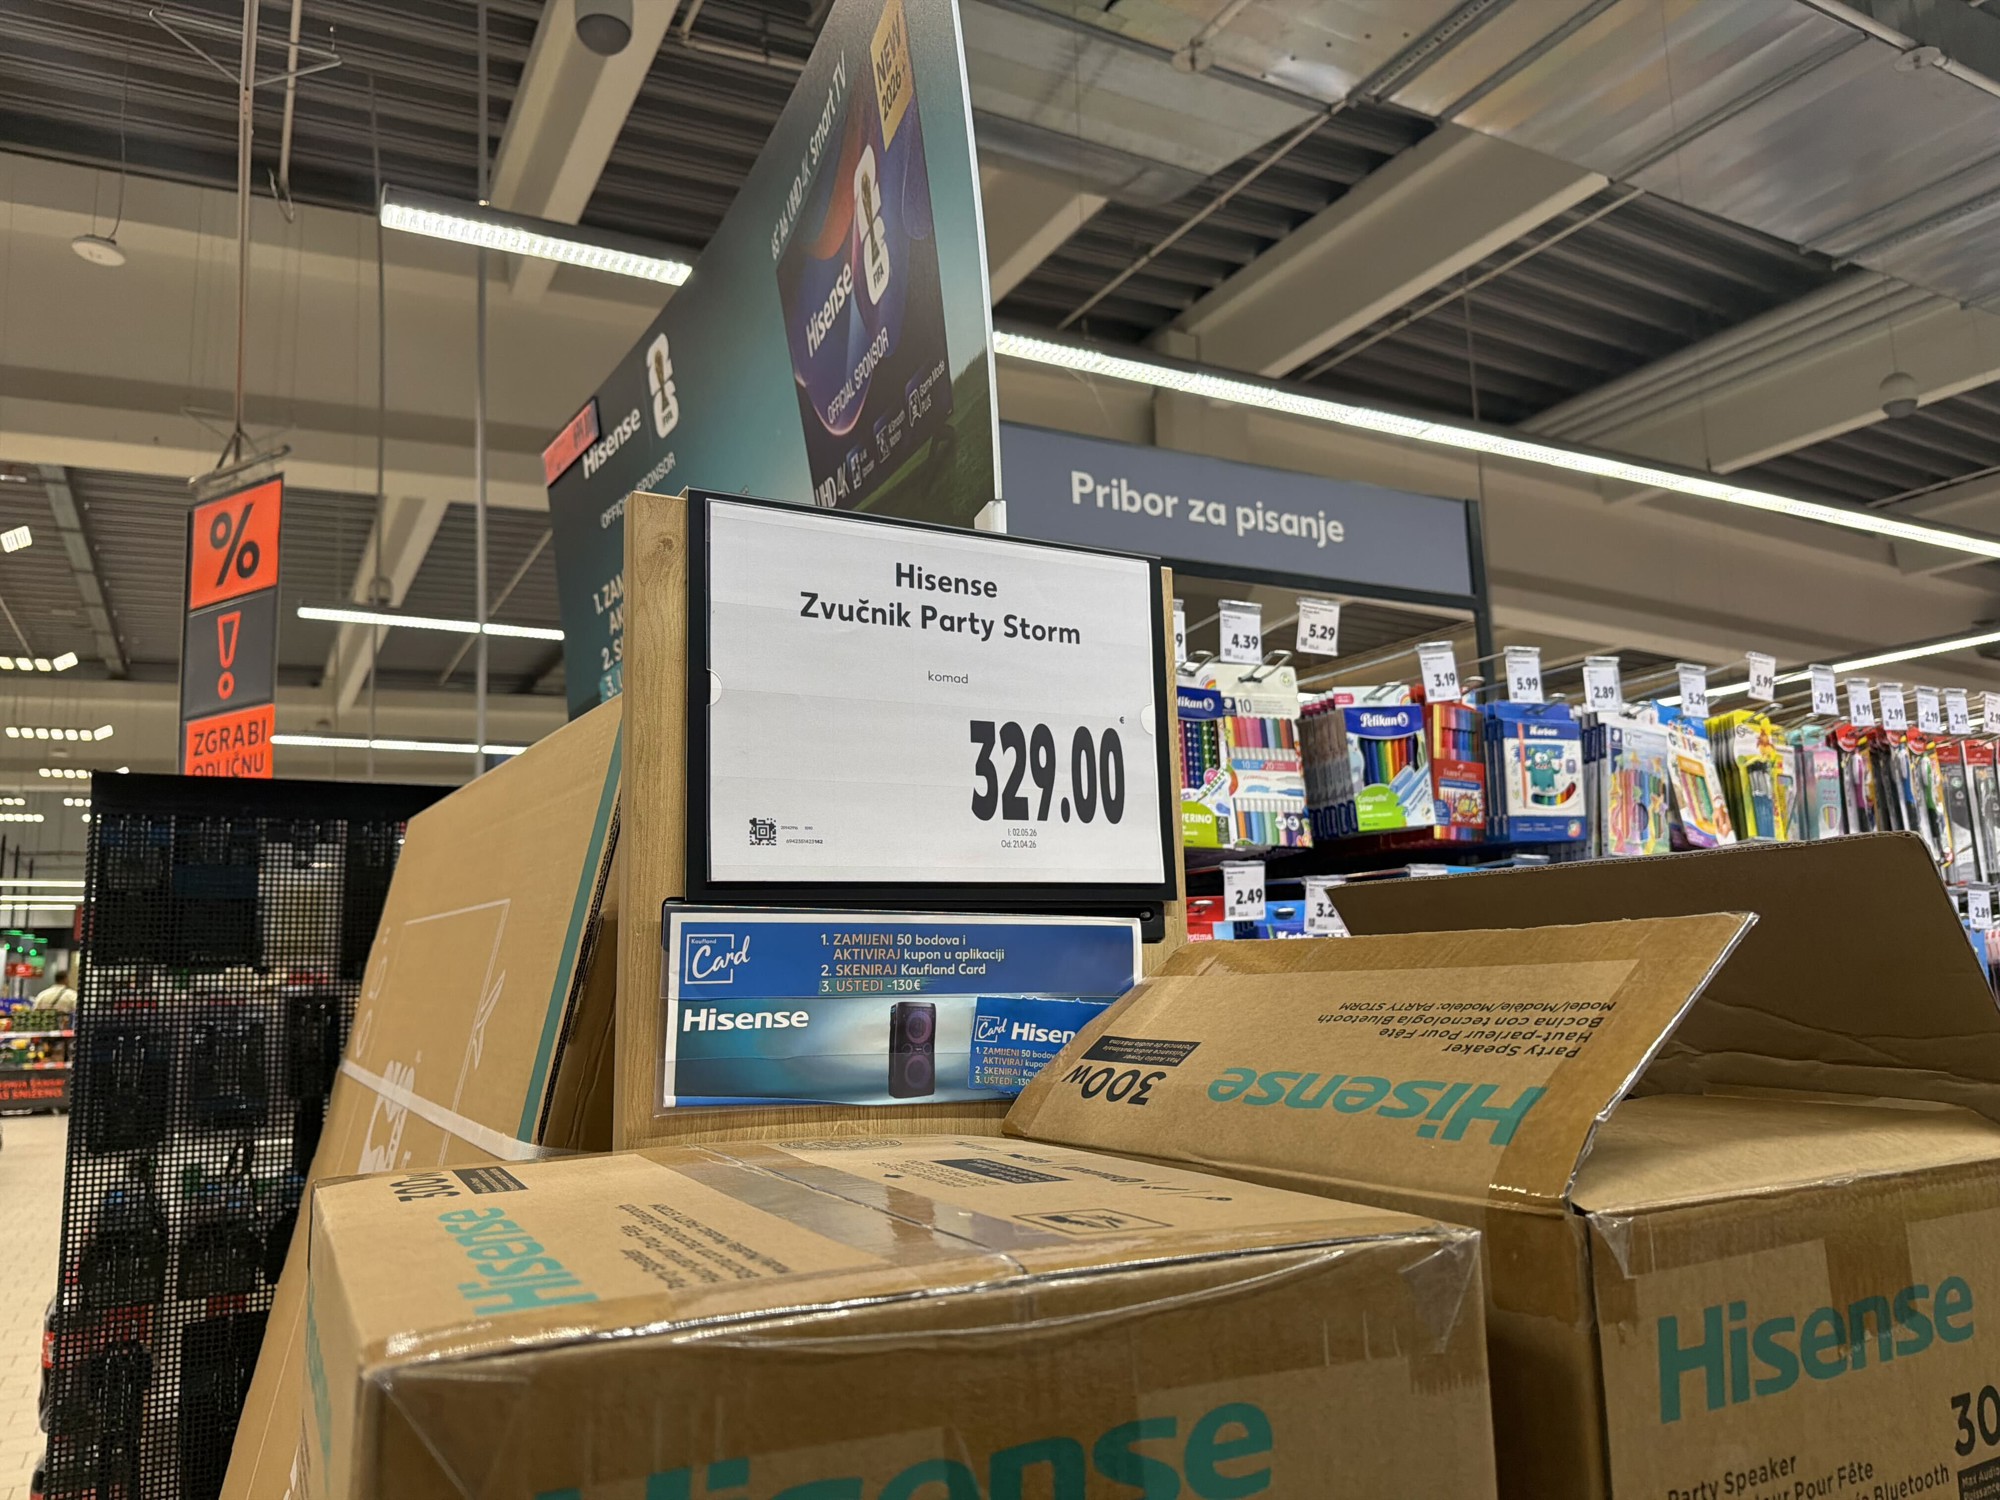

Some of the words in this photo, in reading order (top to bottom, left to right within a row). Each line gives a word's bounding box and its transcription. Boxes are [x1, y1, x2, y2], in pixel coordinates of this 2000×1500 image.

[876, 13, 900, 91] NEW
[882, 71, 900, 121] 2026
[810, 87, 836, 166] Smart
[833, 50, 846, 102] TV
[873, 268, 884, 289] FIFA
[805, 262, 853, 358] Hisense
[827, 382, 855, 425] OFFICIAL
[853, 326, 889, 394] SPONSOR
[582, 408, 642, 480] Hisense
[1070, 469, 1179, 520] Pribor
[1188, 497, 1228, 527] za
[1235, 501, 1346, 549] pisanje
[894, 562, 998, 599] Hisense
[800, 591, 912, 629] Zvučnik
[921, 604, 996, 642] Party
[1003, 614, 1082, 645] Storm
[1308, 623, 1336, 641] 5.29
[1231, 633, 1259, 650] 4.39
[927, 670, 969, 685] komad
[1433, 672, 1456, 688] 3.19
[1516, 677, 1539, 691] 5.99
[1756, 674, 1773, 689] 5.99
[1593, 685, 1615, 700] 2.89
[1688, 692, 1707, 707] 5.29
[1238, 698, 1252, 714] 10
[1359, 712, 1398, 729] Pelikan
[193, 717, 267, 757] ZGRABI
[969, 719, 1126, 825] 329.00
[1012, 828, 1038, 837] 02.05.26
[1001, 840, 1012, 849] Od:
[1013, 840, 1037, 849] 21.04.26
[1235, 888, 1264, 906] 2.49
[821, 934, 829, 946] 1.
[833, 934, 893, 947] ZAMIJENI
[896, 934, 912, 946] 50
[915, 934, 960, 946] bodova
[691, 935, 751, 980] Card
[833, 949, 901, 961] AKTIVIRAJ
[904, 948, 941, 963] kupon
[944, 951, 952, 961] u
[955, 948, 1005, 963] aplikaciji
[821, 964, 832, 977] 2.
[836, 964, 898, 977] SKENIRAJ
[900, 963, 955, 976] Kaufland
[959, 963, 986, 976] Card
[821, 981, 832, 993] 3.
[836, 976, 884, 992] UŠTEDI
[886, 979, 921, 992] -130€
[1339, 1002, 1382, 1012] STORM
[1384, 1002, 1436, 1012] PARTY
[1438, 1001, 1617, 1013] Model/Modèle/Modelo:
[682, 1008, 810, 1032] Hisense
[1316, 1013, 1395, 1026] Bluetooth
[1397, 1013, 1494, 1028] tecnología
[1495, 1016, 1531, 1027] con
[1534, 1016, 1605, 1029] Bocina
[978, 1018, 1008, 1039] Card
[1379, 1027, 1417, 1039] Fête
[1420, 1028, 1461, 1041] Pour
[1464, 1030, 1593, 1044] Haut-parleur
[983, 1046, 1020, 1057] ZAMIJENI
[1021, 1049, 1031, 1058] 50
[1442, 1042, 1521, 1057] Speaker
[1523, 1043, 1581, 1058] Party
[983, 1057, 1024, 1067] AKTIVIRAJ
[984, 1067, 1021, 1077] SKENIRAJ
[984, 1074, 1012, 1085] UŠTEDI
[1207, 1067, 1549, 1147] Hisense
[437, 1206, 599, 1317] Hisense
[1657, 1275, 1976, 1425] Hisense
[1723, 1454, 1797, 1496] Speaker
[1794, 1474, 1834, 1500] Pour
[1837, 1461, 1874, 1490] Fête
[1874, 1462, 1950, 1500] Bluetooth
